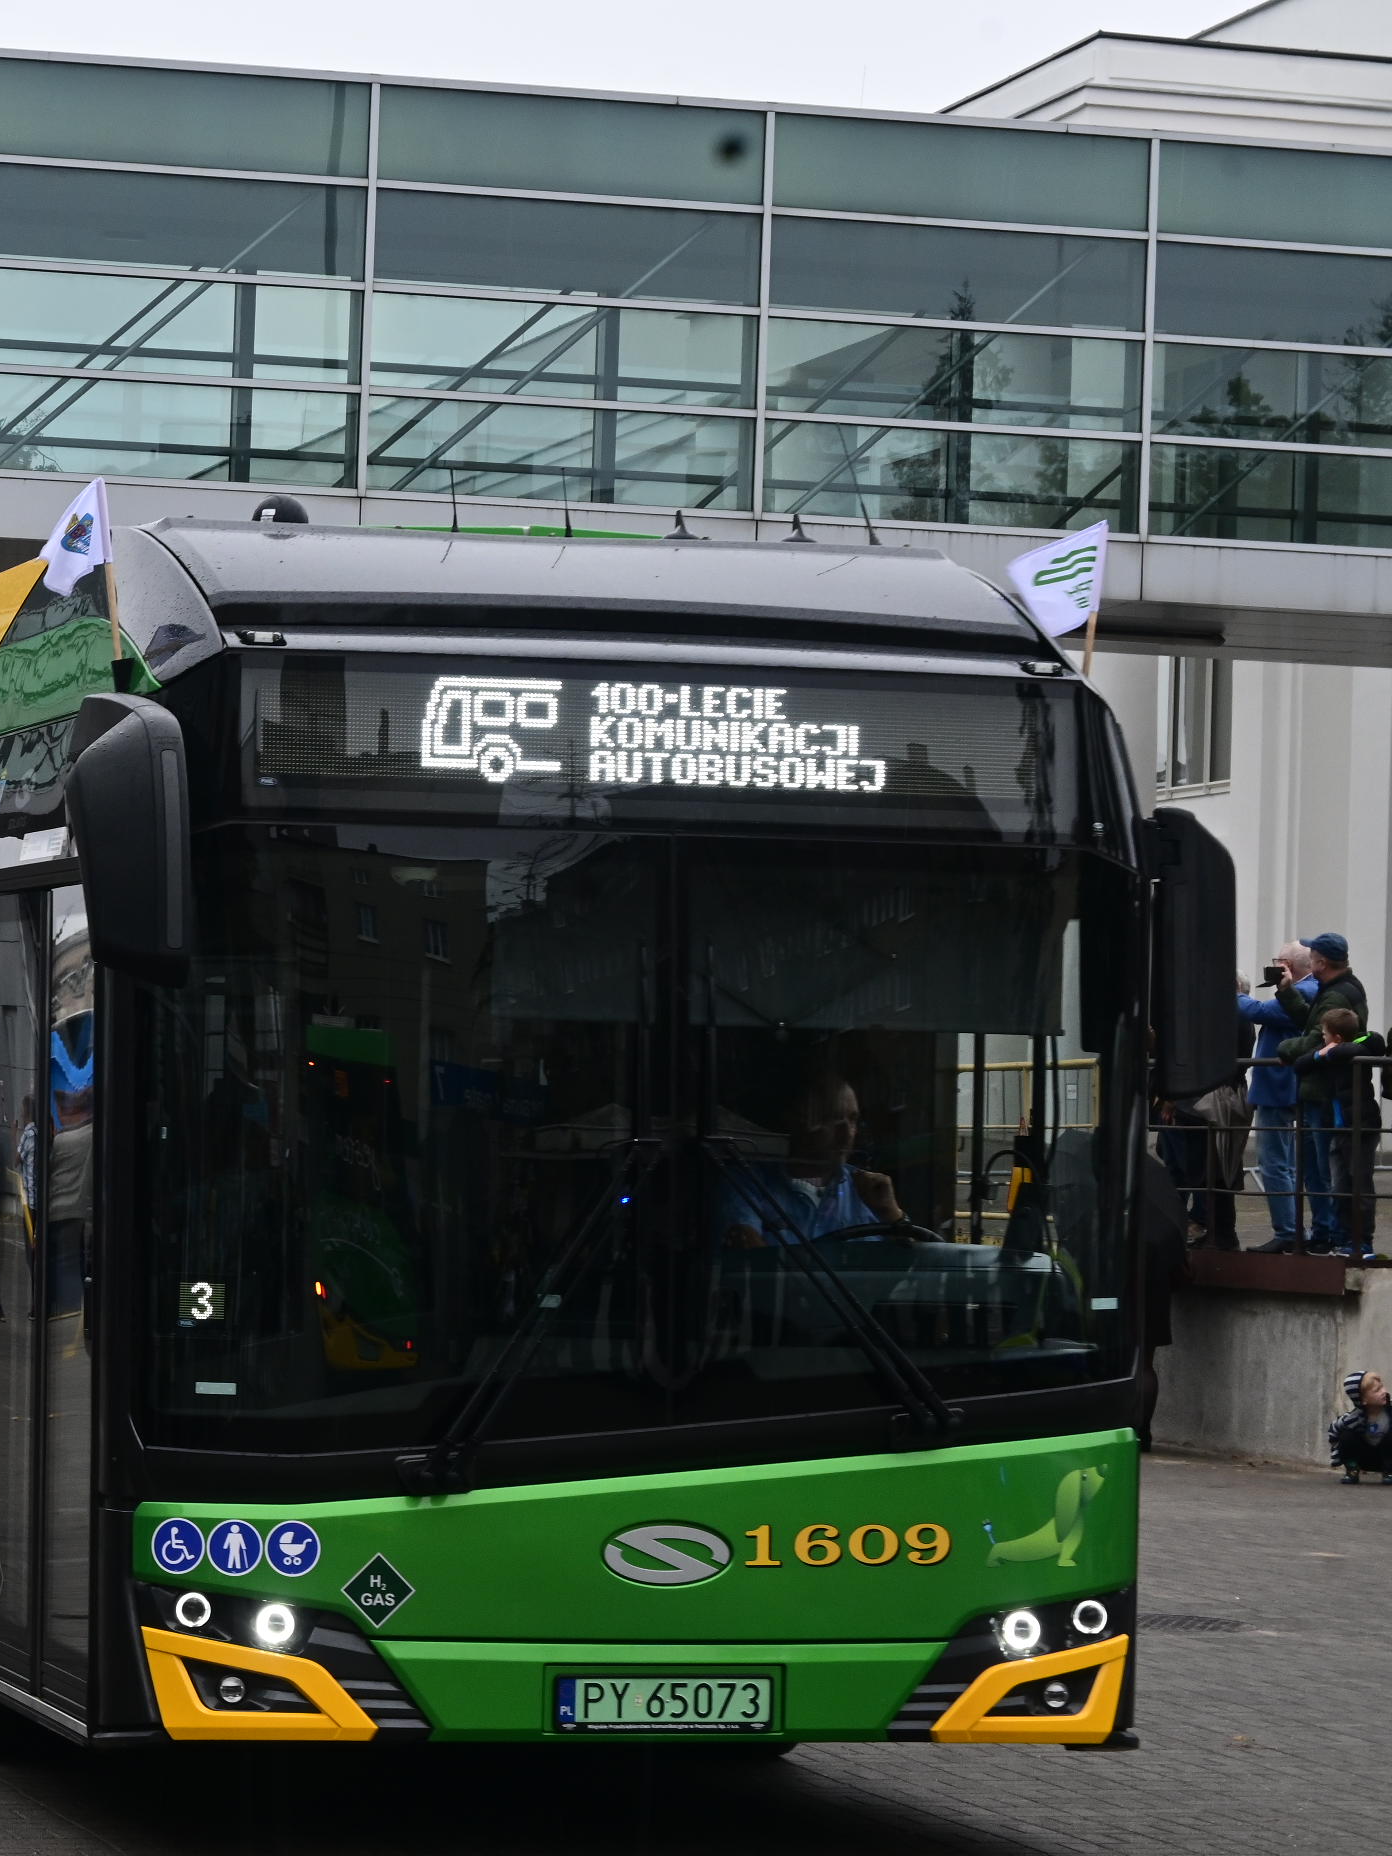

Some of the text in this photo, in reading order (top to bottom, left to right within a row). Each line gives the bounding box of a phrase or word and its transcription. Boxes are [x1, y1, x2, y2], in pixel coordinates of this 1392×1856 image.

[591, 682, 788, 720] 100-LECIE
[589, 716, 861, 756] KOMUNIKACJI
[588, 749, 887, 792] AUTOBUSOWEJ
[191, 1282, 213, 1320] 3
[745, 1523, 951, 1566] 1609
[360, 1592, 396, 1607] GAS
[559, 1705, 574, 1716] PL
[583, 1682, 761, 1719] PY 65073
